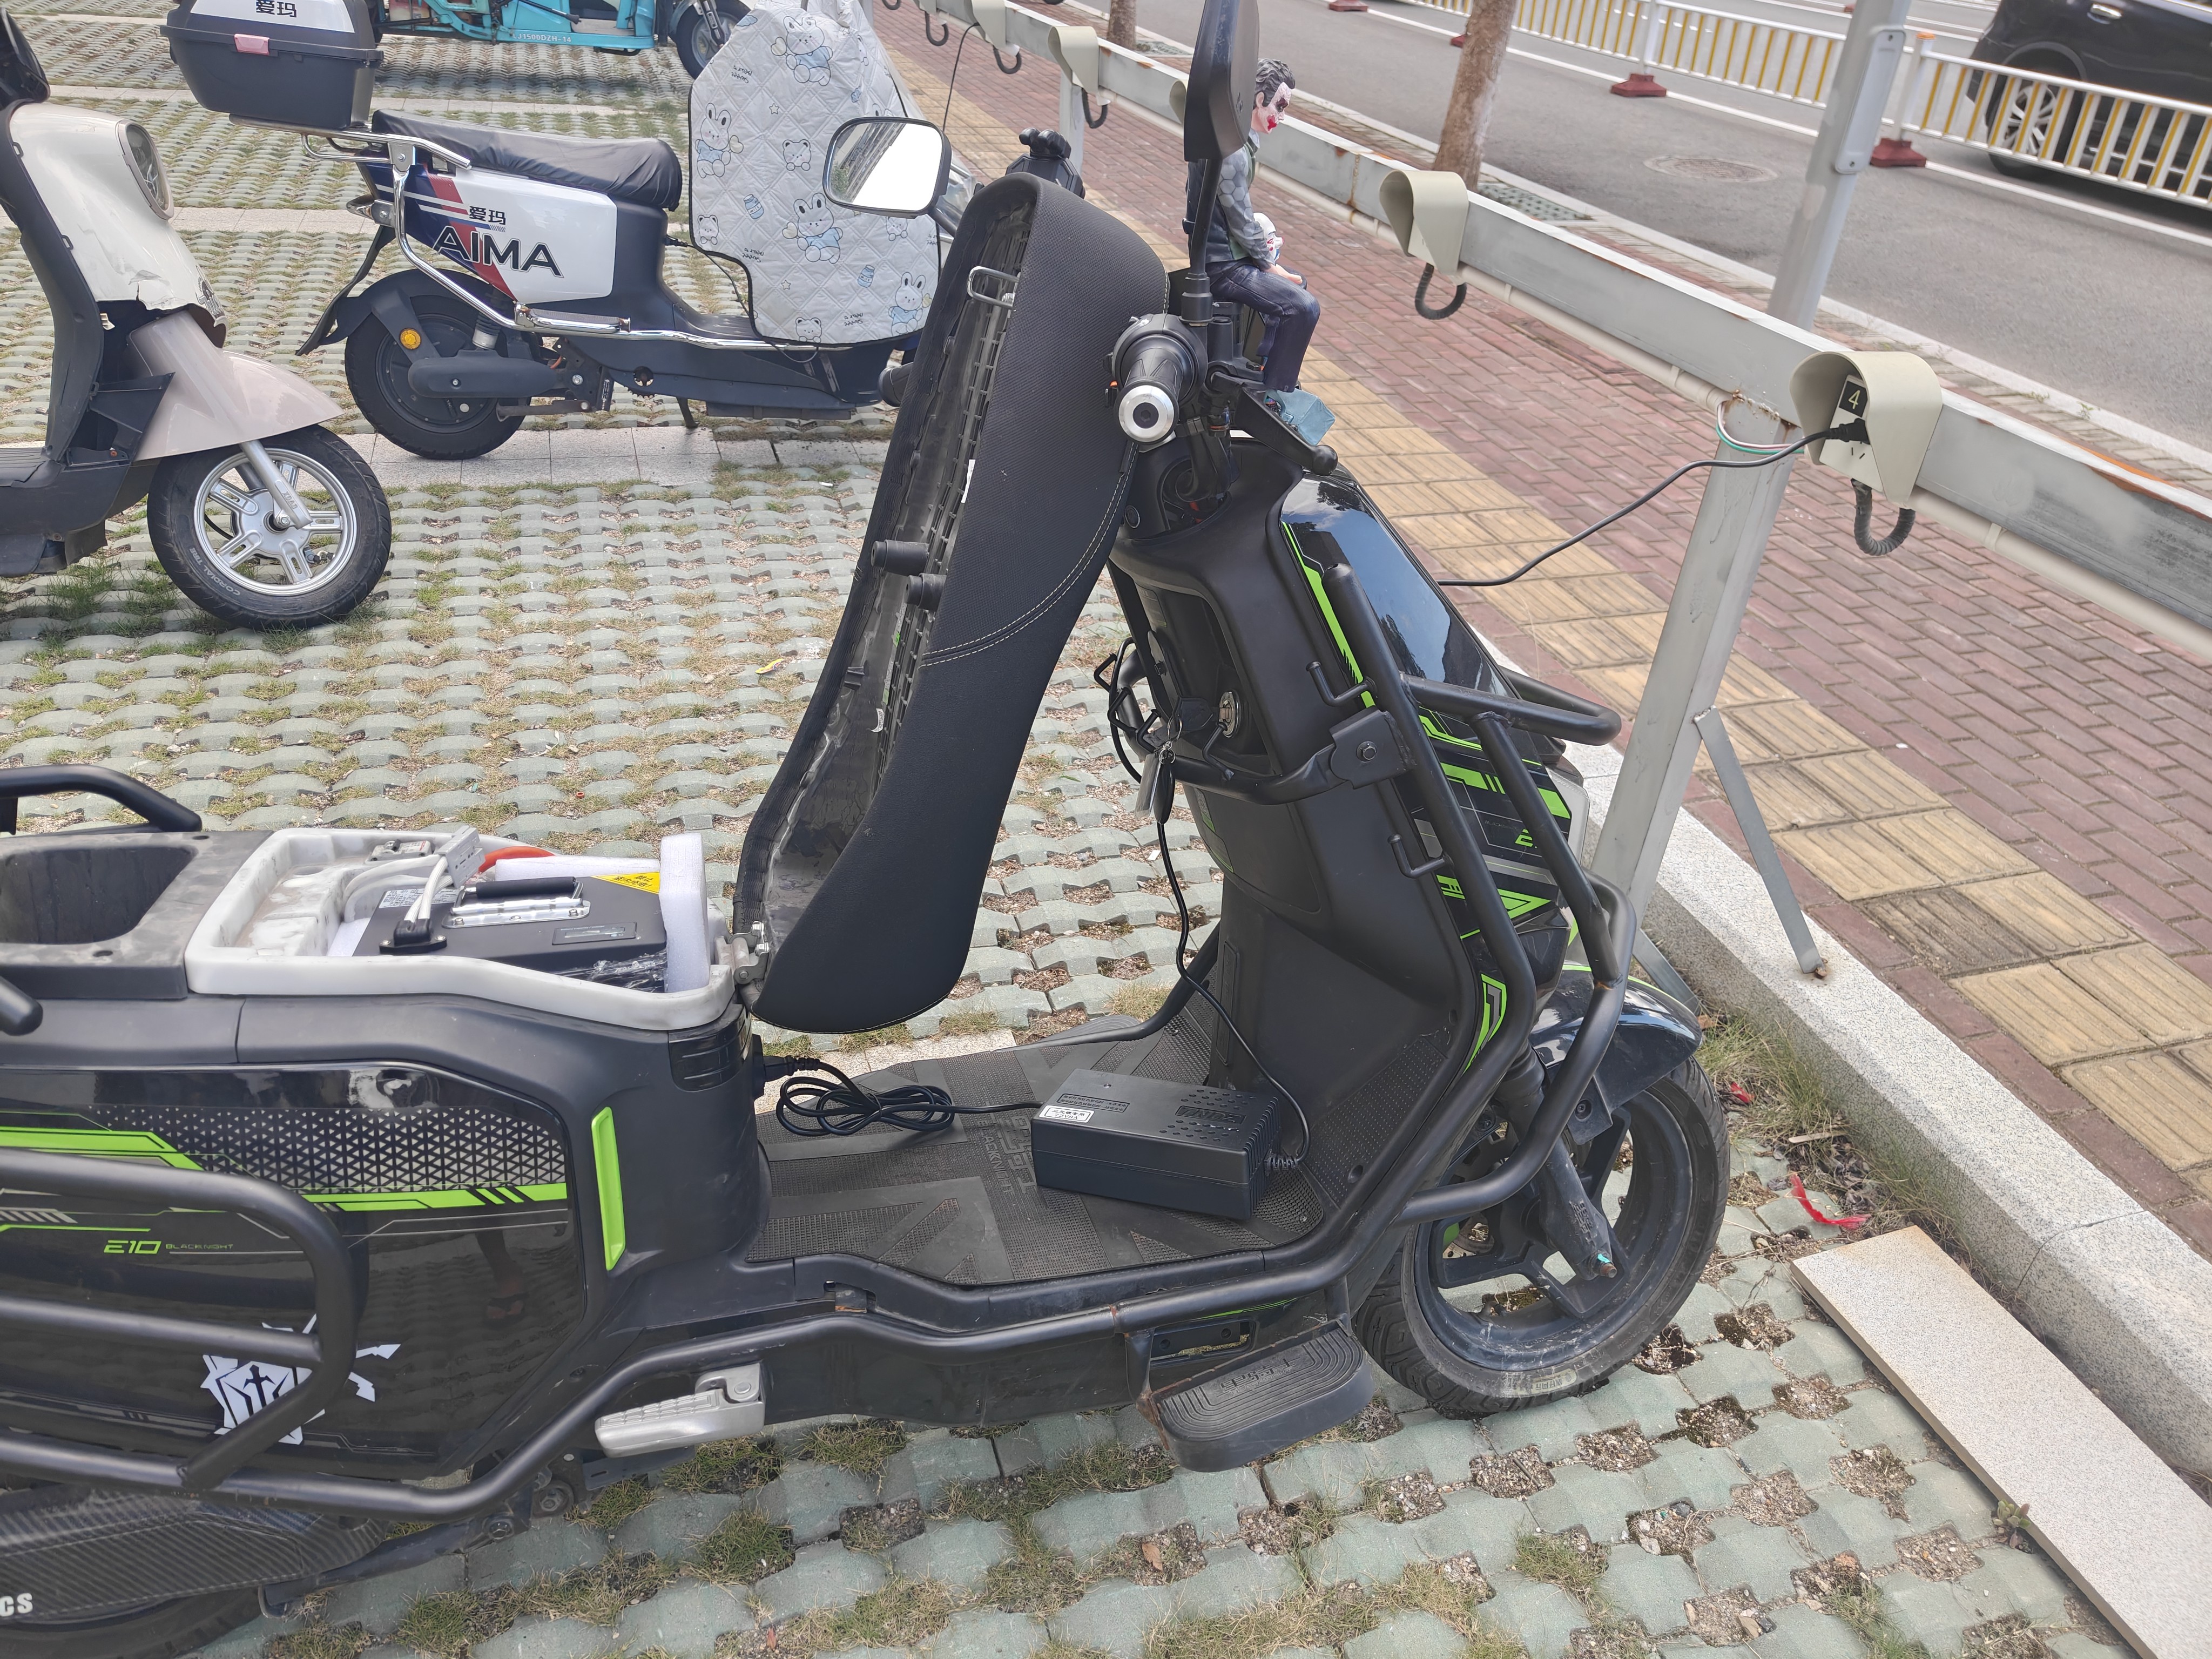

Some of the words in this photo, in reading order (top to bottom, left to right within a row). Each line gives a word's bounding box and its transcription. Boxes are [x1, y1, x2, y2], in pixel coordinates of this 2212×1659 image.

[256, 0, 296, 17] 爱玛
[469, 206, 506, 225] 爱玛
[432, 226, 564, 278] AIMA
[1848, 390, 1860, 409] 4
[189, 547, 203, 565] TIRE
[204, 565, 240, 596] CORDIAL
[103, 1240, 161, 1254] E10
